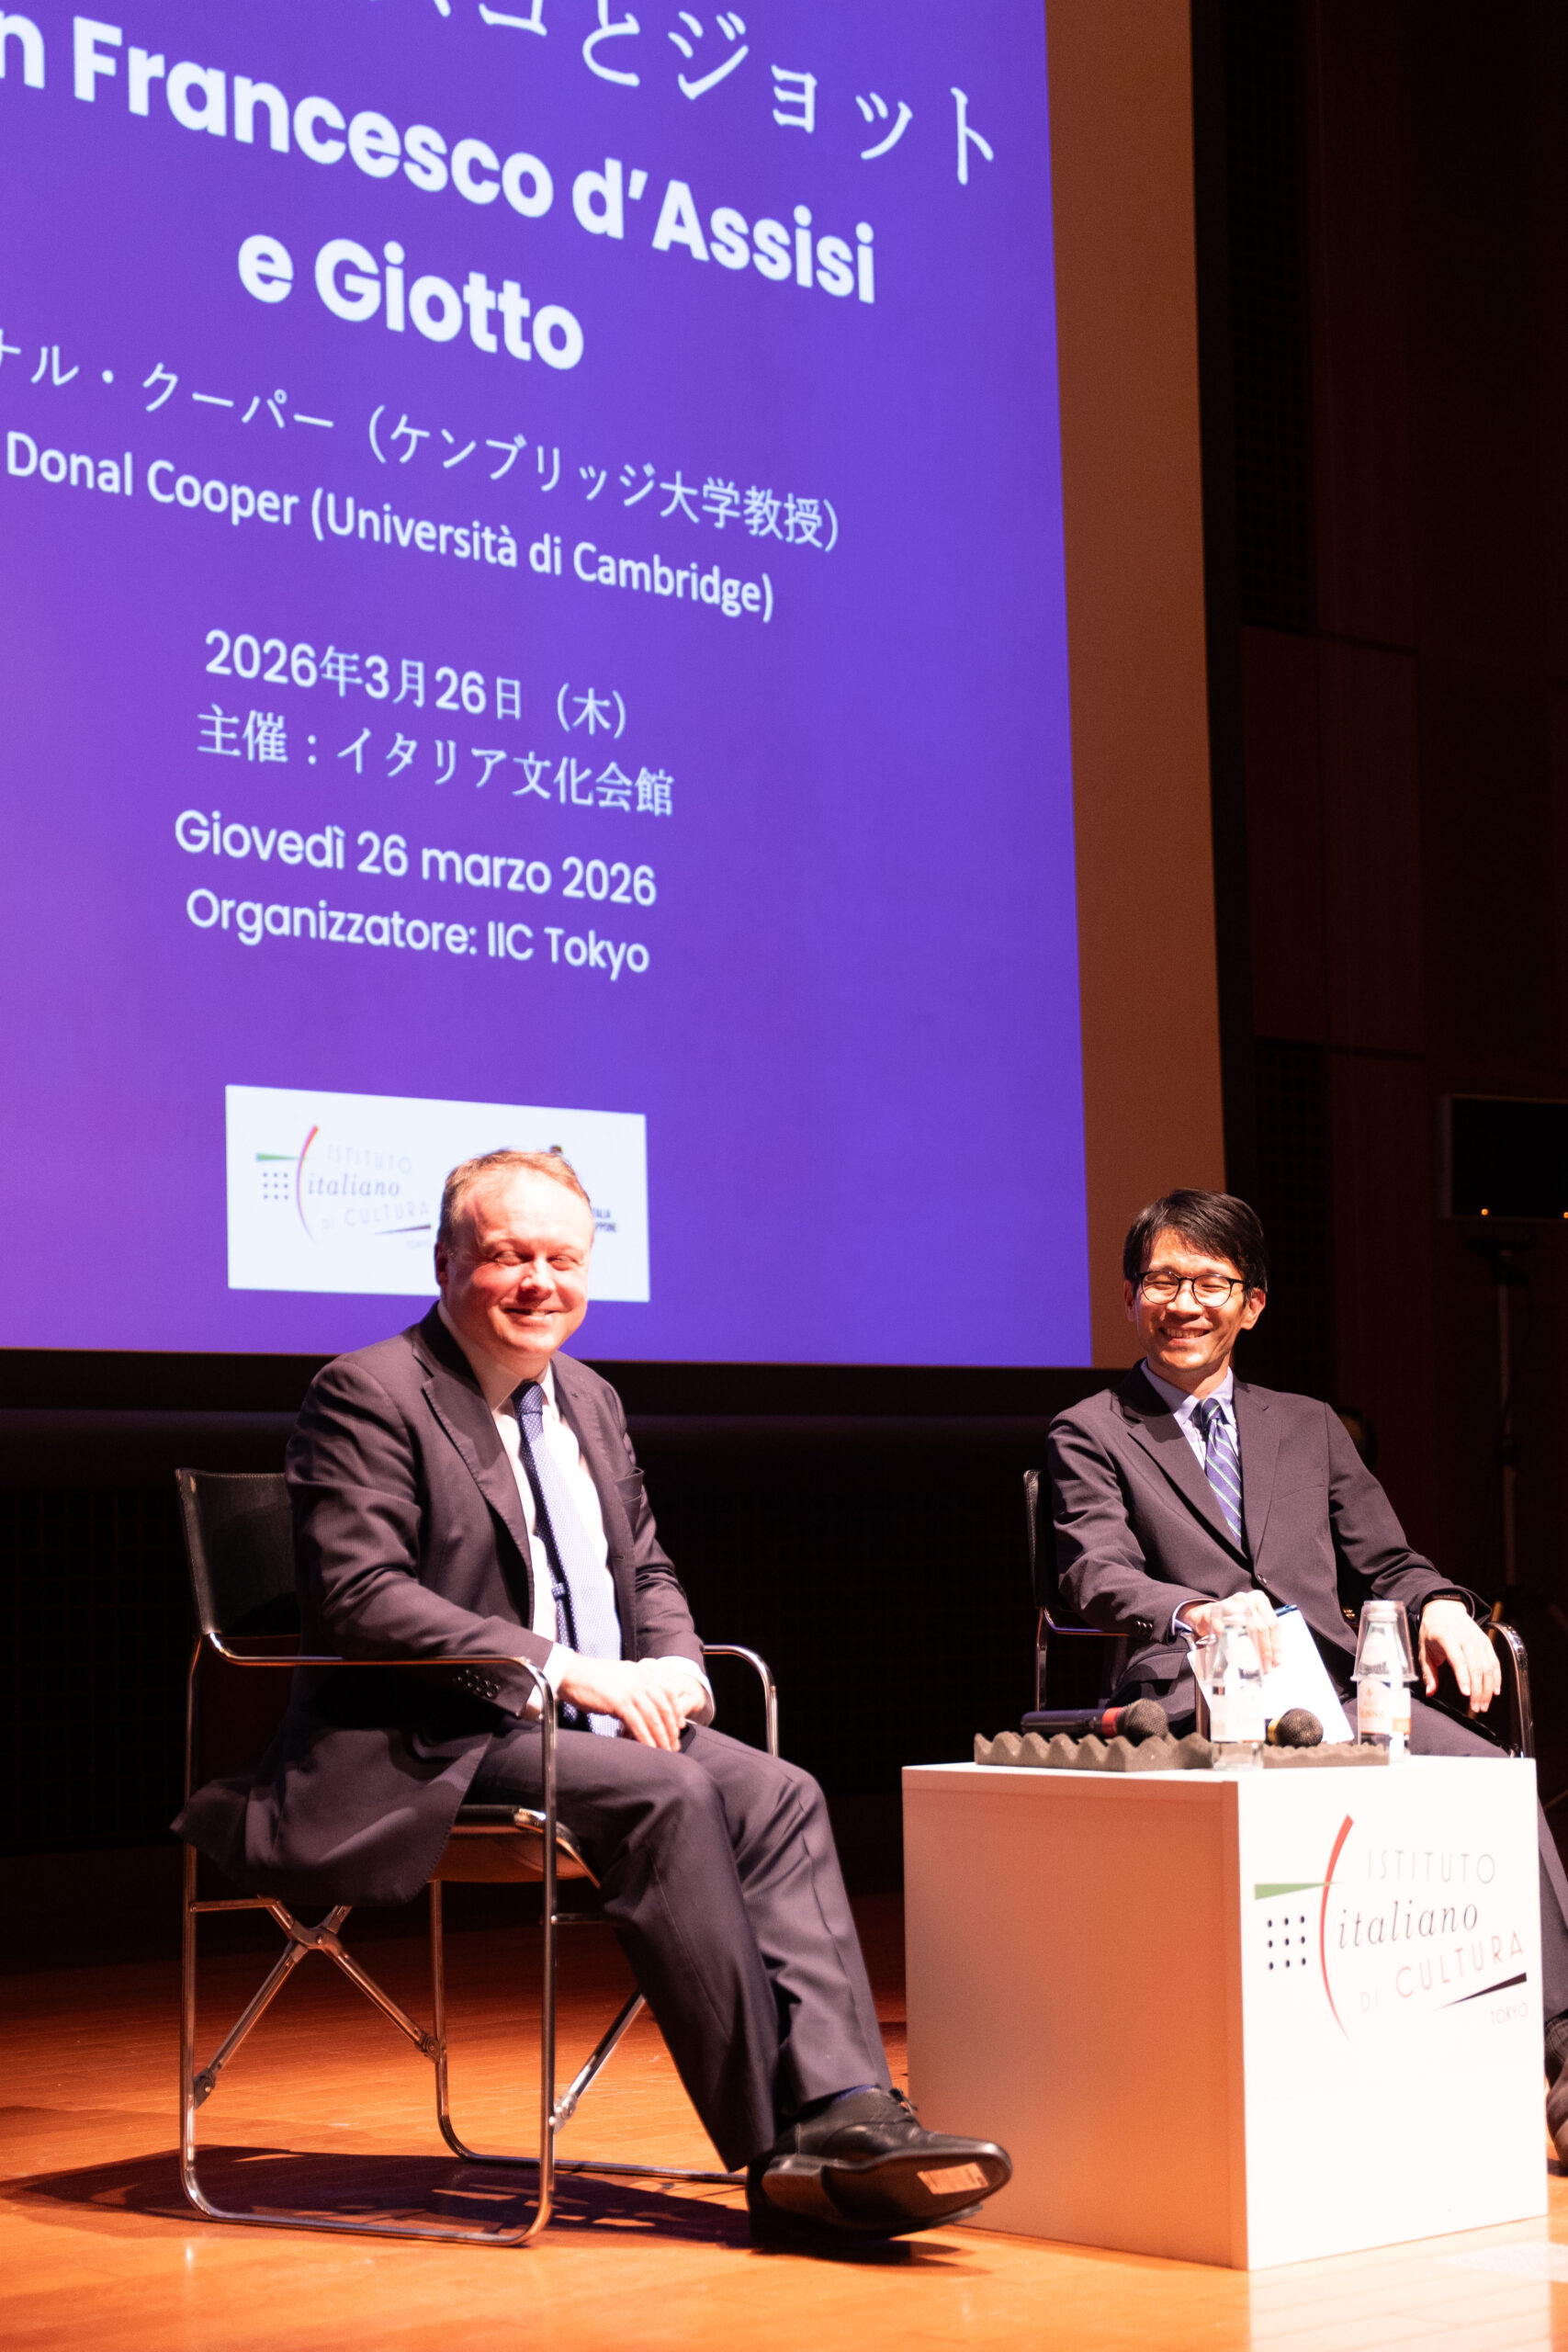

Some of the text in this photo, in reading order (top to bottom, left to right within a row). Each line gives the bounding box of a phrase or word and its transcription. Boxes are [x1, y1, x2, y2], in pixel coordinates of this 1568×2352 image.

[73, 15, 554, 219] Francesco
[237, 233, 584, 370] e Giotto
[6, 430, 773, 623] Donal Cooper (Università di Cambridge)
[175, 808, 657, 907] Giovedì 26 marzo 2026
[186, 888, 650, 982] Organizzatore: IIC Tokyo
[308, 1172, 400, 1197] italiano
[326, 1144, 412, 1175] ISTITUTO
[344, 1200, 430, 1227] CULTURA
[1367, 1849, 1496, 1884] ISTITUTO
[1338, 1899, 1479, 1950] italiano
[1359, 1929, 1525, 2013] DI CULTURA
[1490, 2002, 1529, 2026] TOKYO
